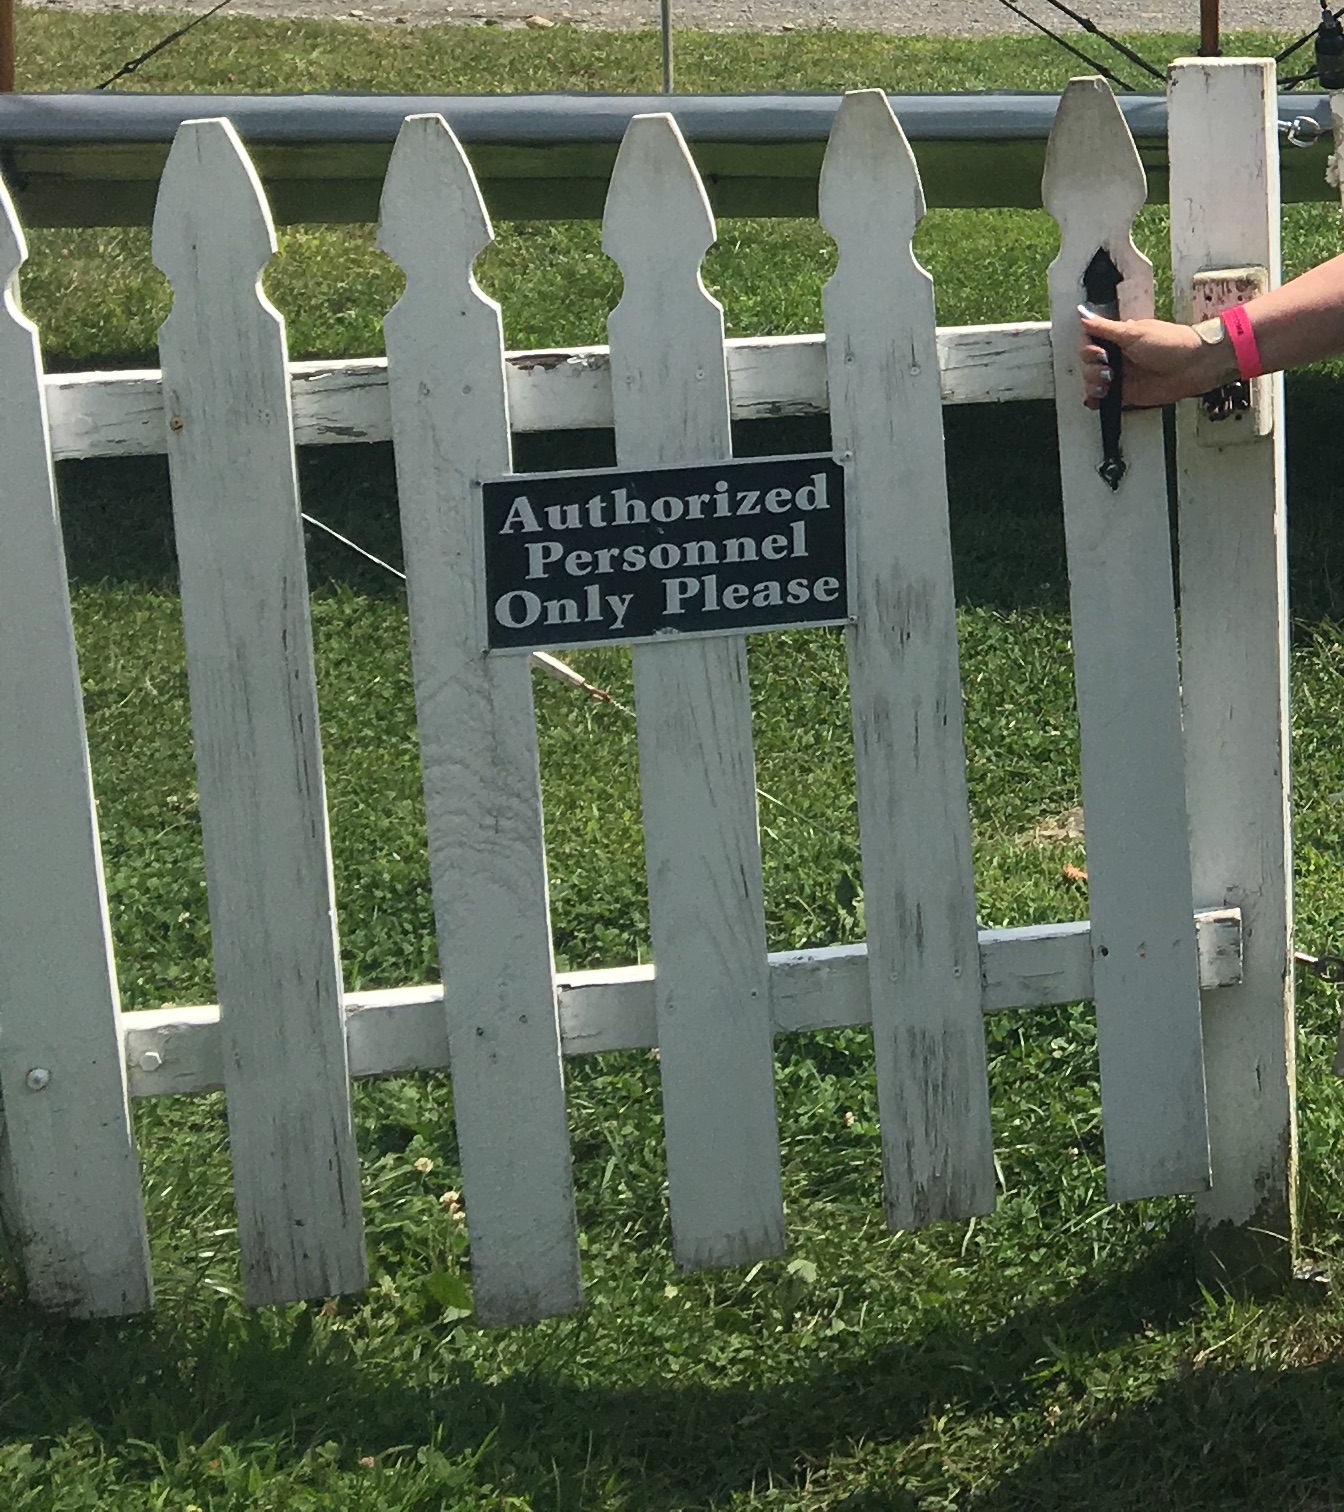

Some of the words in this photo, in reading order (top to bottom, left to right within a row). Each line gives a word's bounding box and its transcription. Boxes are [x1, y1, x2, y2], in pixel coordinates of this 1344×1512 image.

[499, 472, 831, 536] Authorized
[523, 520, 810, 580] Personnel
[494, 584, 635, 630] Only
[661, 574, 840, 616] Please
